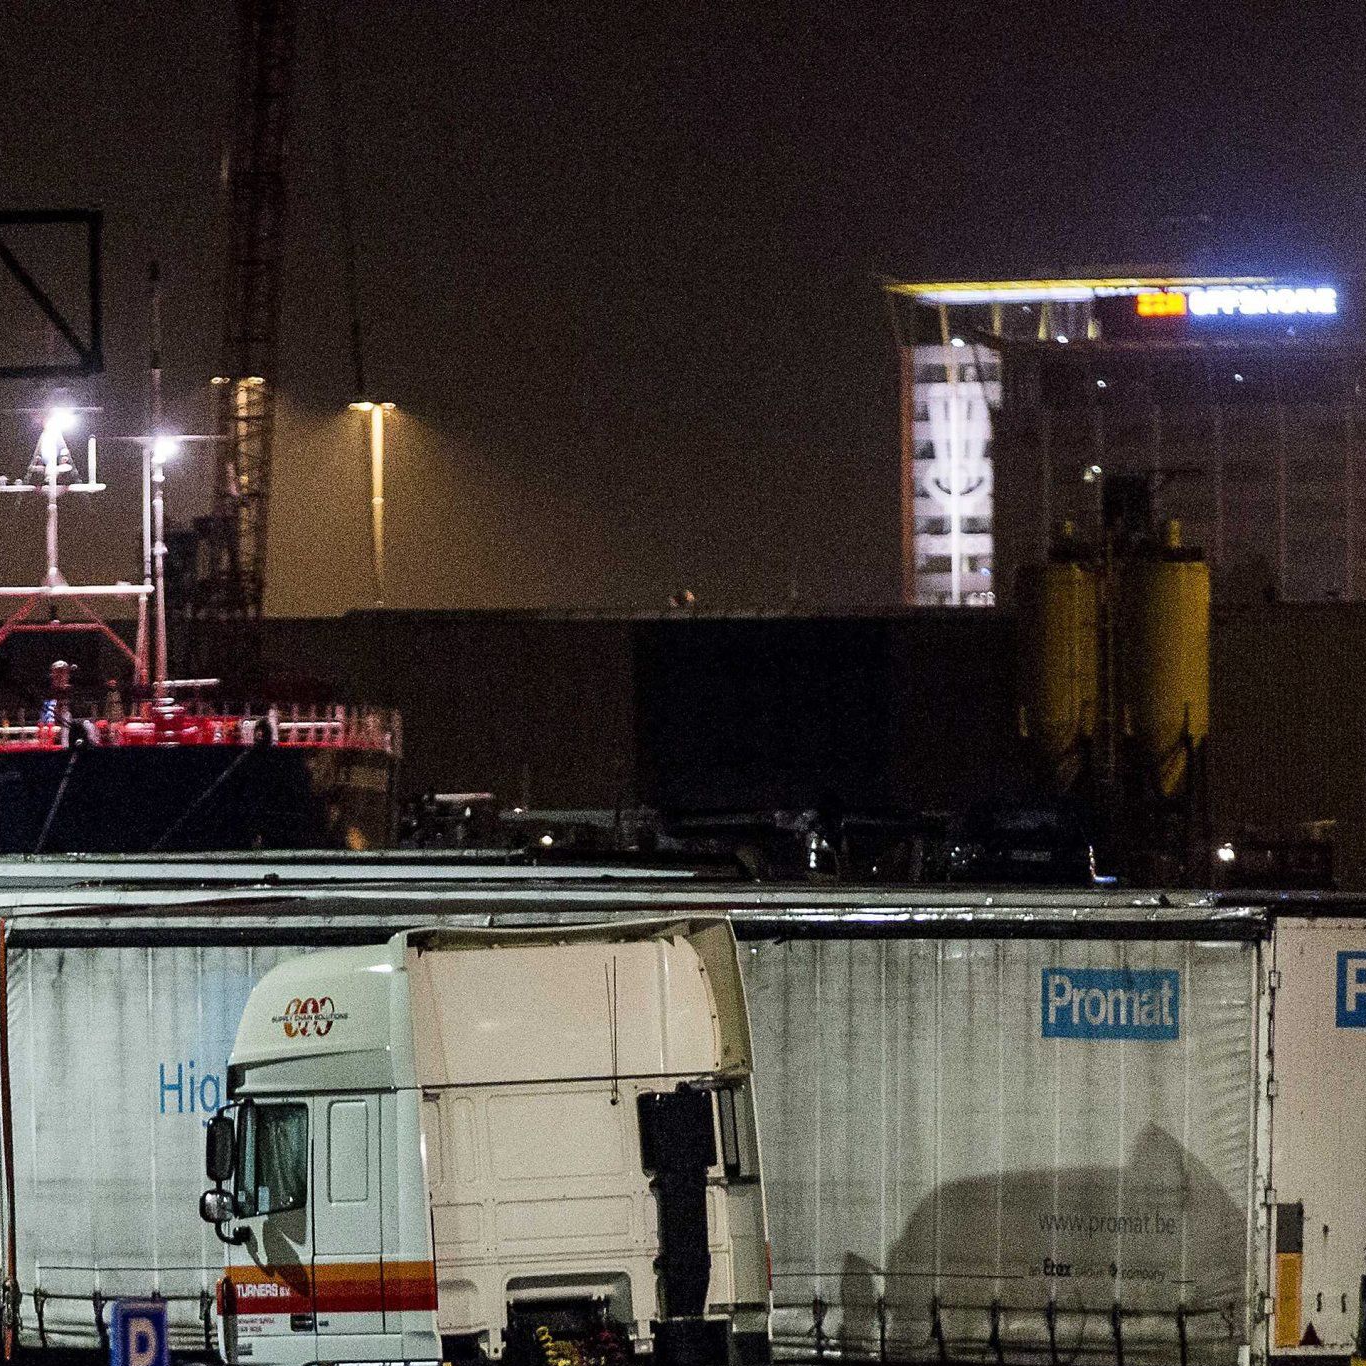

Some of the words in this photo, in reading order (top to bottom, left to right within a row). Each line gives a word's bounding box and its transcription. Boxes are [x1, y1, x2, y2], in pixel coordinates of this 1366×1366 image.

[1048, 974, 1174, 1026] Promat
[159, 1060, 231, 1128] Hig
[1038, 1210, 1176, 1239] www.promat.be
[236, 1283, 279, 1297] TURNERS
